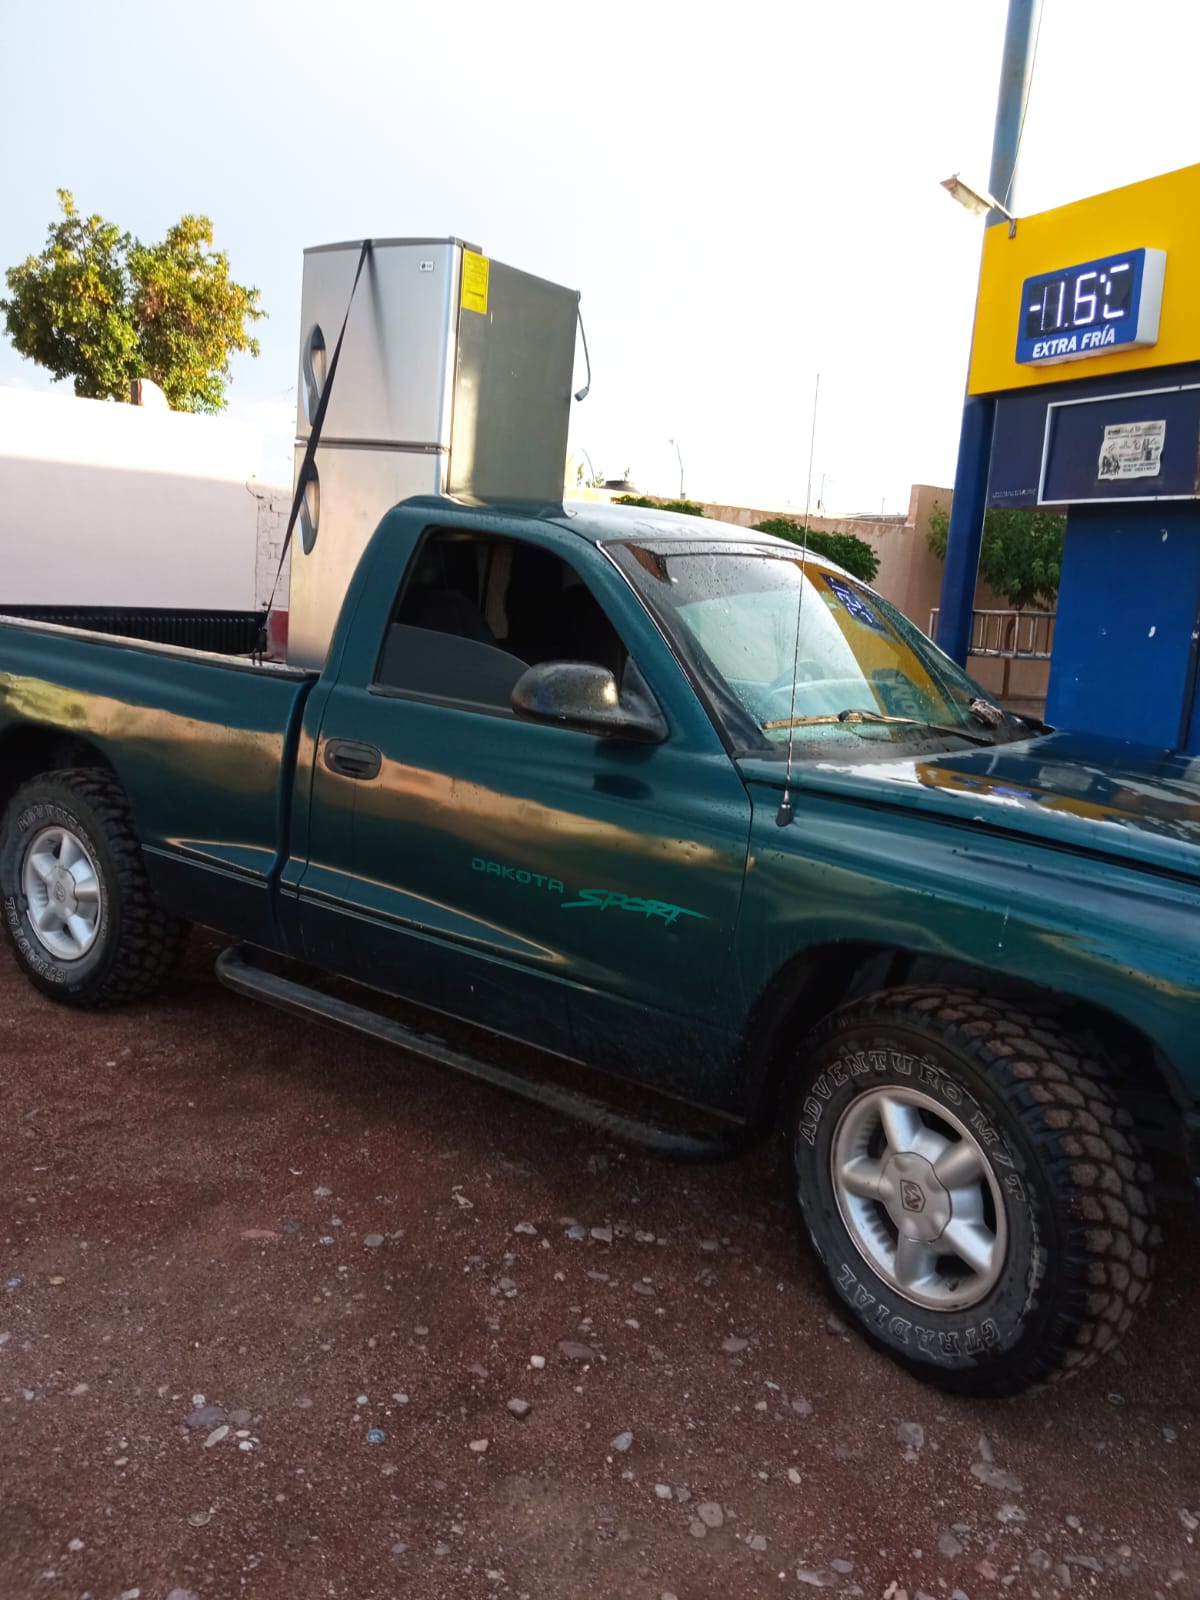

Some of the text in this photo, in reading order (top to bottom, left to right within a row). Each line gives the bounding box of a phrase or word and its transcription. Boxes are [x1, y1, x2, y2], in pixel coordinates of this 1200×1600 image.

[1032, 324, 1115, 359] EXTRA FRÍA
[471, 857, 711, 926] DAKOTA SPORT
[799, 1050, 963, 1146] ADVENTURO
